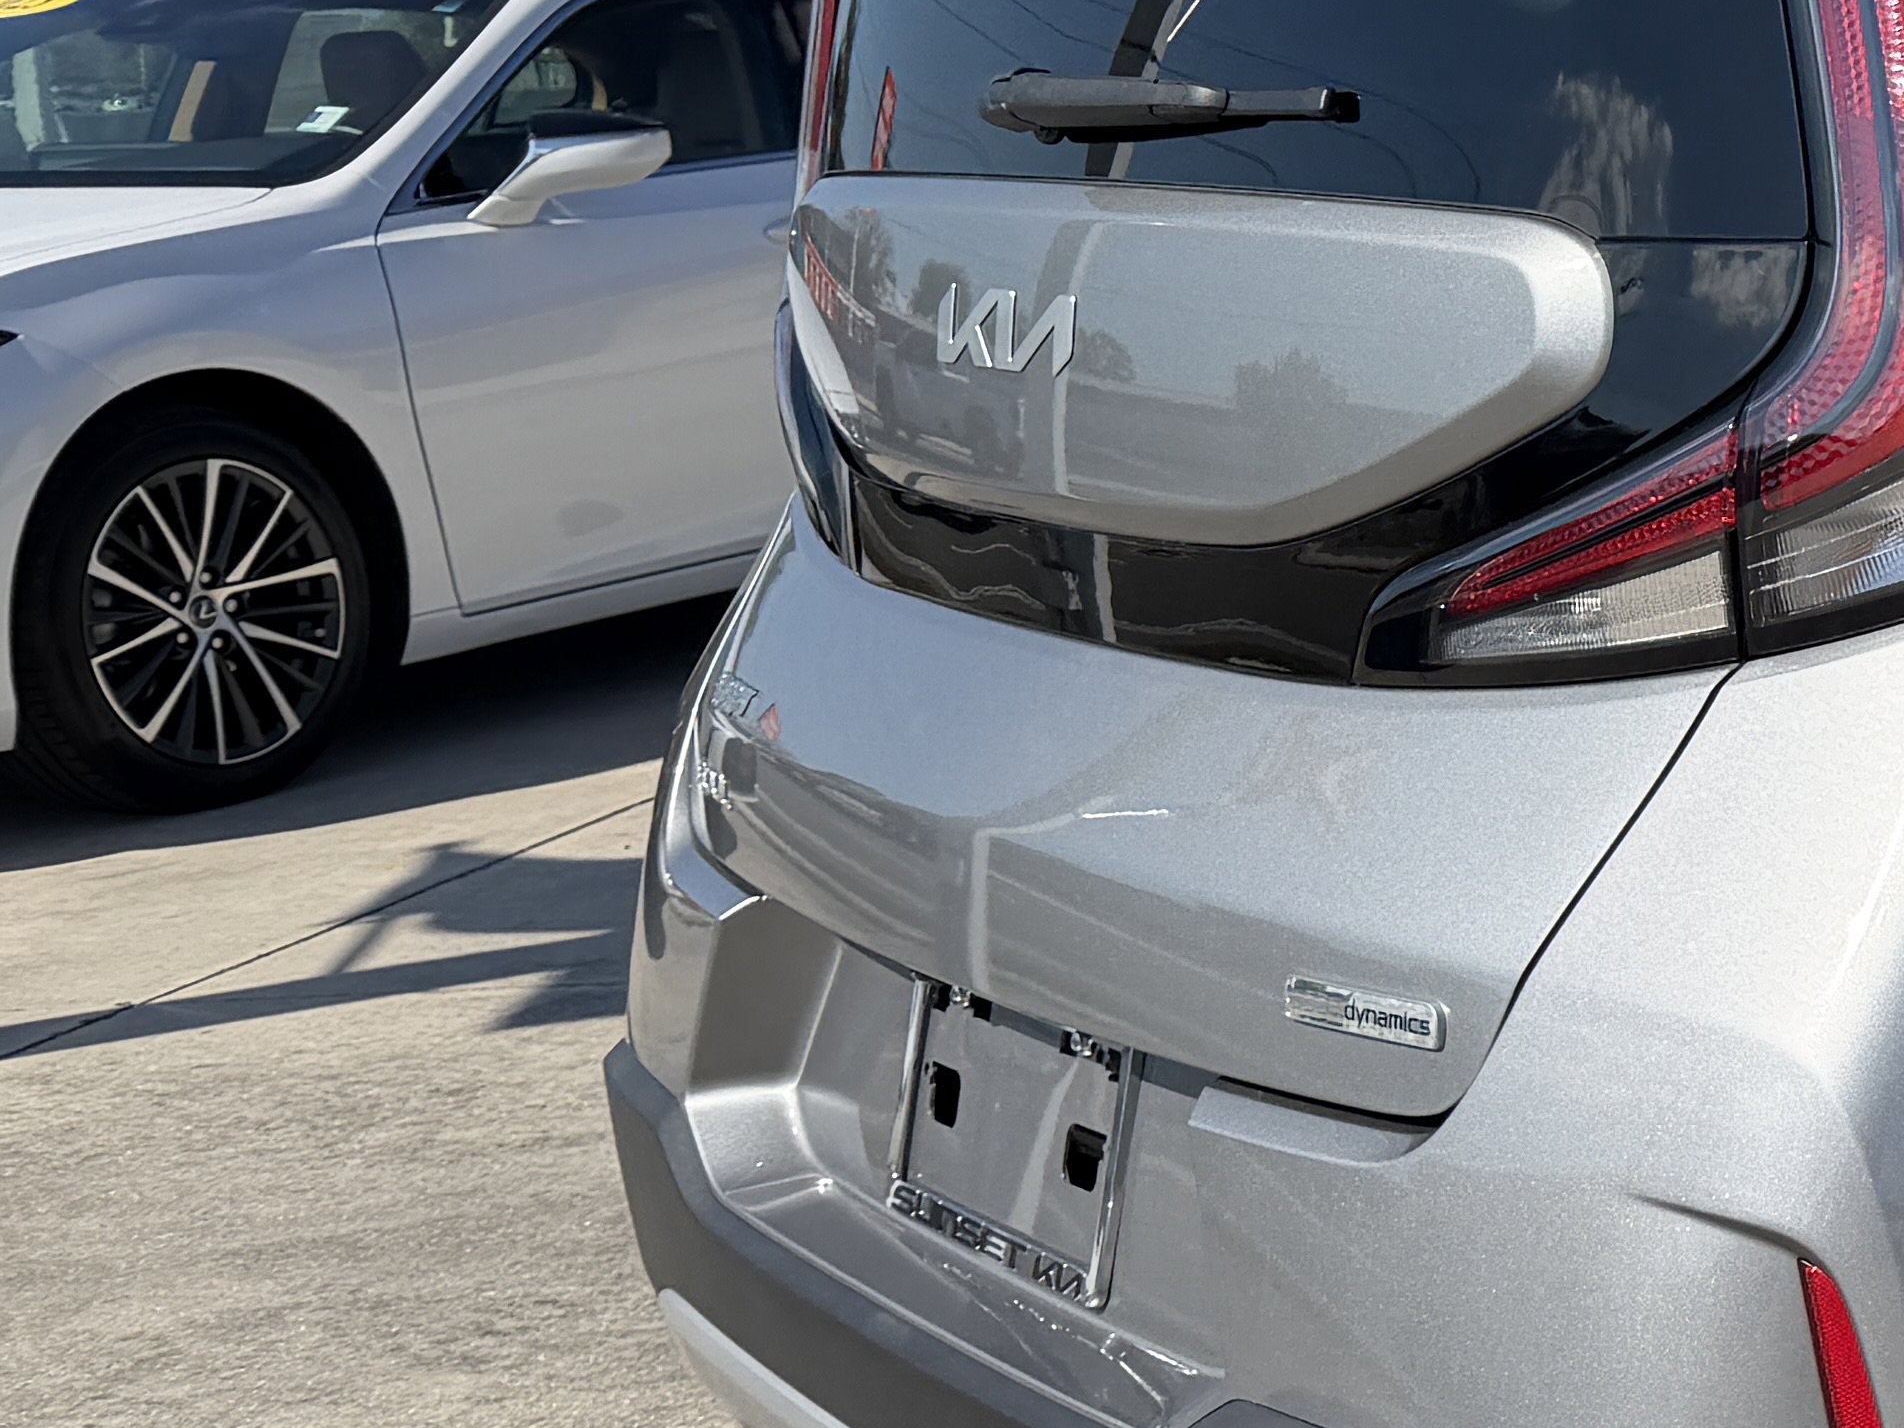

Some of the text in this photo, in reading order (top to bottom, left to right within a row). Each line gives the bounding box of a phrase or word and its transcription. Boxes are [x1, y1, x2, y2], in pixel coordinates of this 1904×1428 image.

[936, 282, 1077, 378] KIA
[1343, 997, 1431, 1036] dynamics
[888, 1181, 1087, 1301] SUNSET KIA
